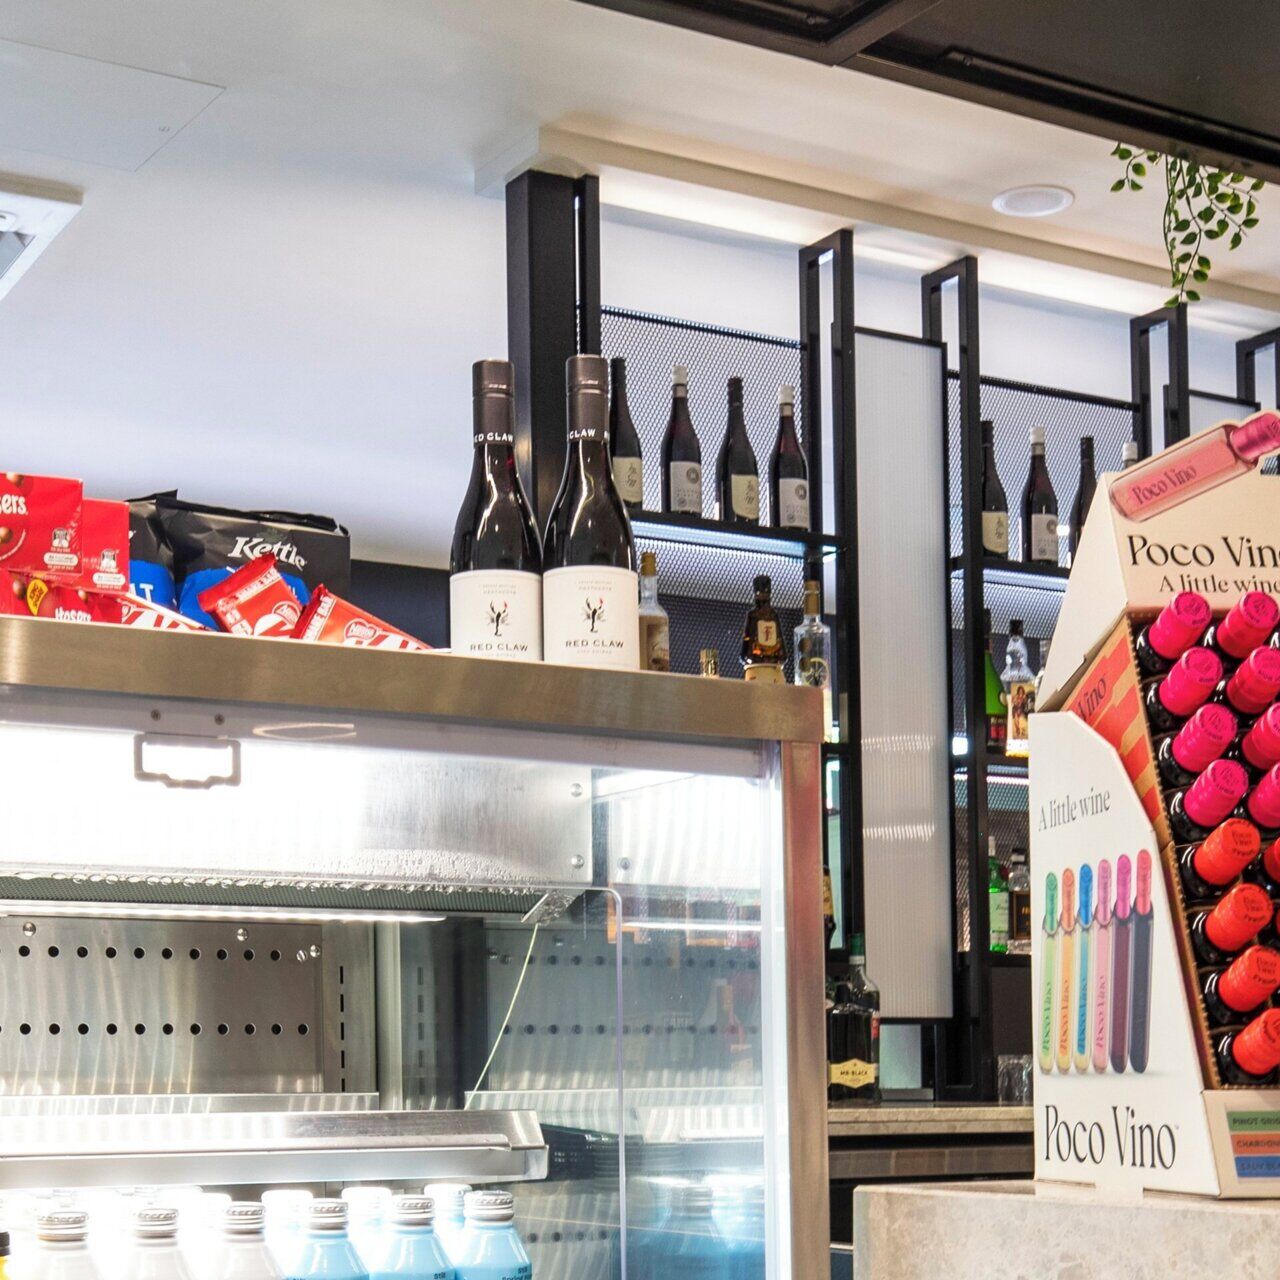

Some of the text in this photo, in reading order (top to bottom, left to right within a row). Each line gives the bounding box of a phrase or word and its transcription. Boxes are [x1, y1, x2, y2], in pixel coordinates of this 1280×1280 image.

[1132, 464, 1197, 504] Poco Vino
[228, 536, 306, 571] Kettle
[1127, 535, 1215, 567] Poco
[1159, 575, 1174, 592] A
[1179, 574, 1229, 593] little
[470, 642, 528, 652] RED CLAW
[566, 639, 624, 649] RED CLAW
[1038, 788, 1111, 832] A little wine
[1232, 1117, 1258, 1125] PINOT
[1045, 1105, 1177, 1170] Poco Vino
[433, 1272, 446, 1280] Still
